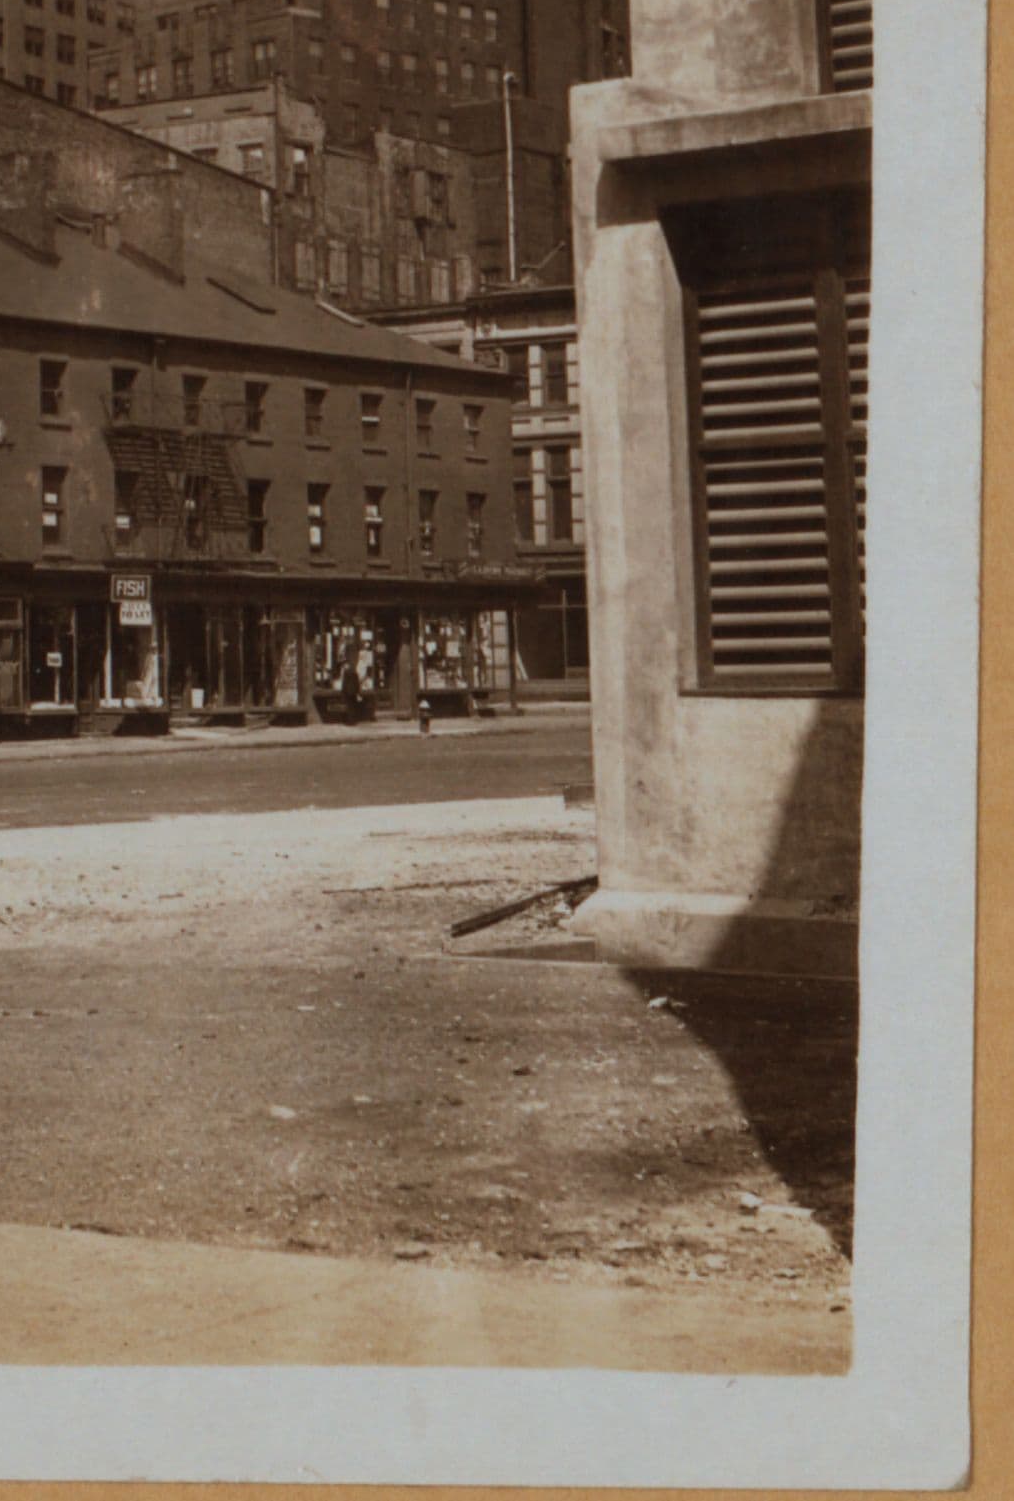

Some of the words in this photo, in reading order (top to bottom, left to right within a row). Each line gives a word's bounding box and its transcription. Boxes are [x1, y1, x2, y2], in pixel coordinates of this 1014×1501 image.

[116, 579, 145, 597] FISH
[121, 610, 133, 620] TO
[134, 610, 151, 620] LET
